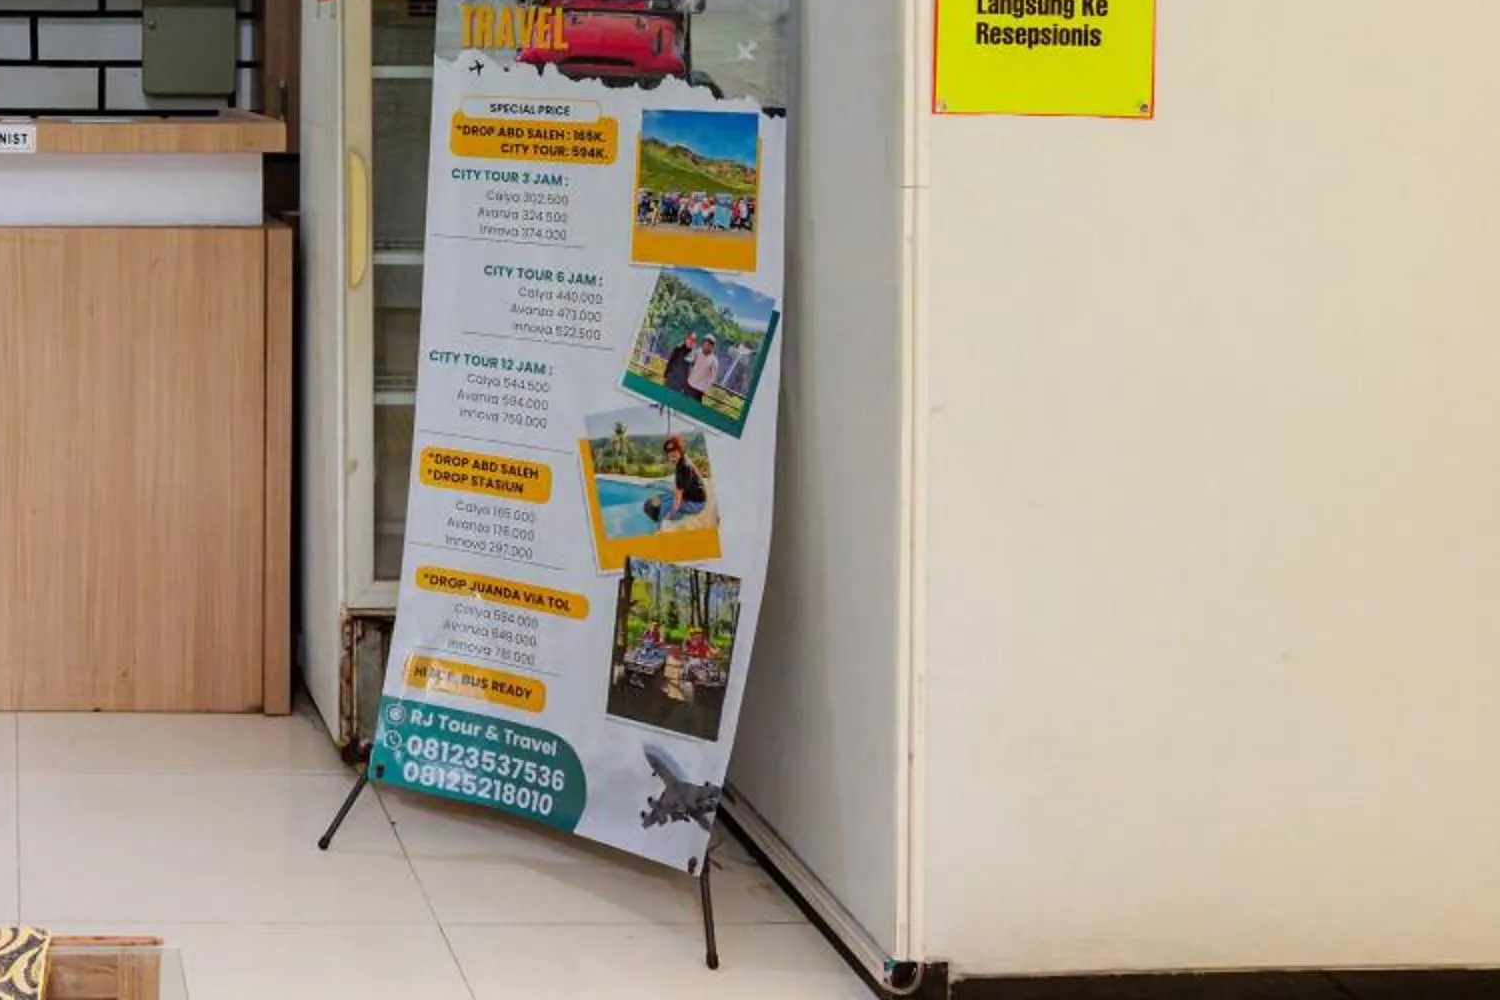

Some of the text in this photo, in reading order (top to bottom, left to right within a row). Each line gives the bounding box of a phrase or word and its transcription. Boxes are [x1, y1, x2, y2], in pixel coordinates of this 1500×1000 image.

[460, 2, 568, 50] TRAVEL
[975, 22, 1102, 49] Resepsionis
[489, 103, 571, 117] SPECIAL PRICE
[499, 126, 525, 139] ABD
[527, 128, 565, 141] SALEH
[500, 143, 530, 155] CITY
[451, 167, 482, 180] CITY
[485, 169, 519, 183] TOUR
[532, 172, 563, 186] JAM
[483, 264, 513, 278] CITY
[516, 268, 553, 282] TOUR
[556, 271, 564, 283] 6
[566, 271, 597, 287] JAM
[429, 349, 461, 363] CITY
[464, 353, 499, 368] TOUR
[516, 360, 547, 375] JAM
[471, 458, 498, 473] ABD
[500, 464, 540, 480] SALEH
[471, 476, 524, 495] STASIUN
[470, 581, 521, 601] JUANDA
[522, 591, 546, 605] VIA
[547, 596, 572, 613] TOL
[460, 672, 488, 690] BUS
[491, 678, 533, 700] READY
[410, 709, 559, 758] RJ Tour & Travel
[406, 735, 566, 792] 08123537536
[403, 759, 554, 816] 08125218010
